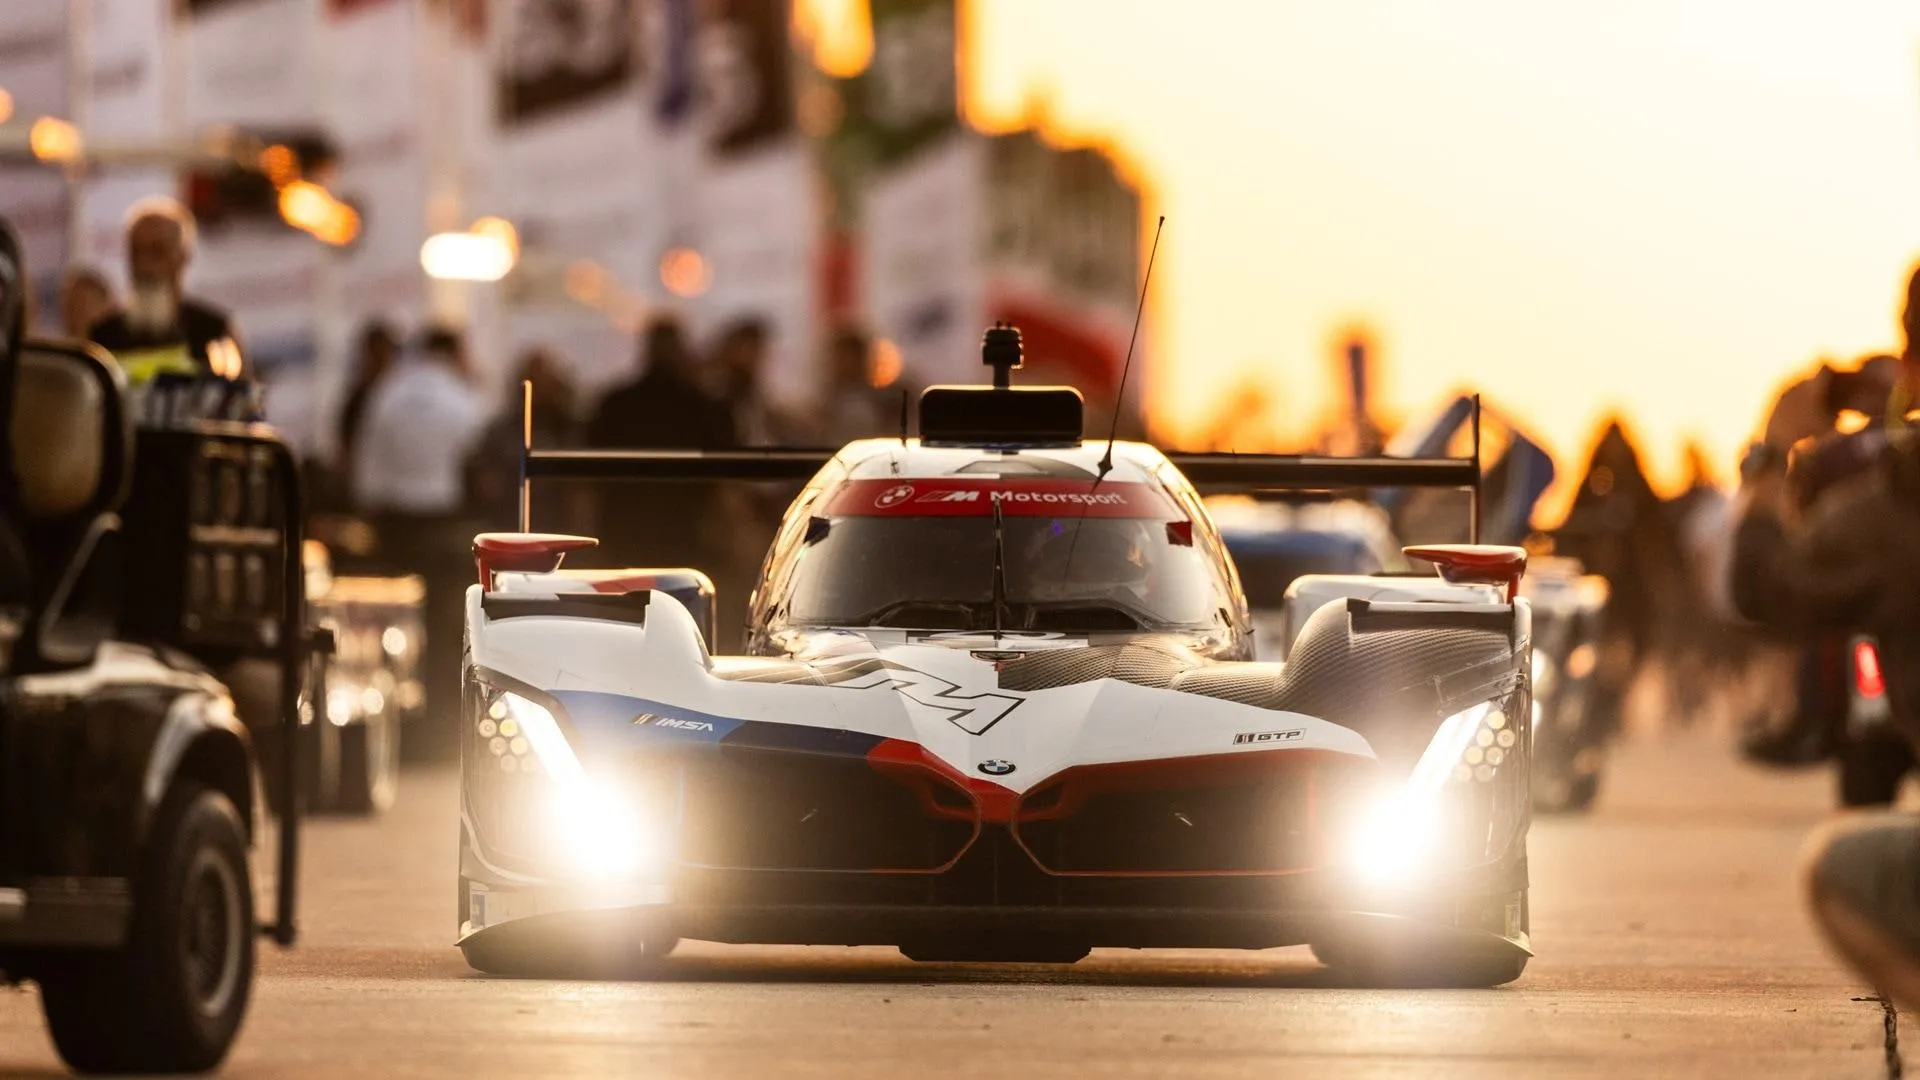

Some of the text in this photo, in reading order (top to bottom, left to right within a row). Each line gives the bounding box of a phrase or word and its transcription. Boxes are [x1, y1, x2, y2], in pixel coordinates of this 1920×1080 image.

[990, 491, 1127, 505] Motorsport
[656, 717, 713, 731] IMSA
[1257, 731, 1300, 740] GTP
